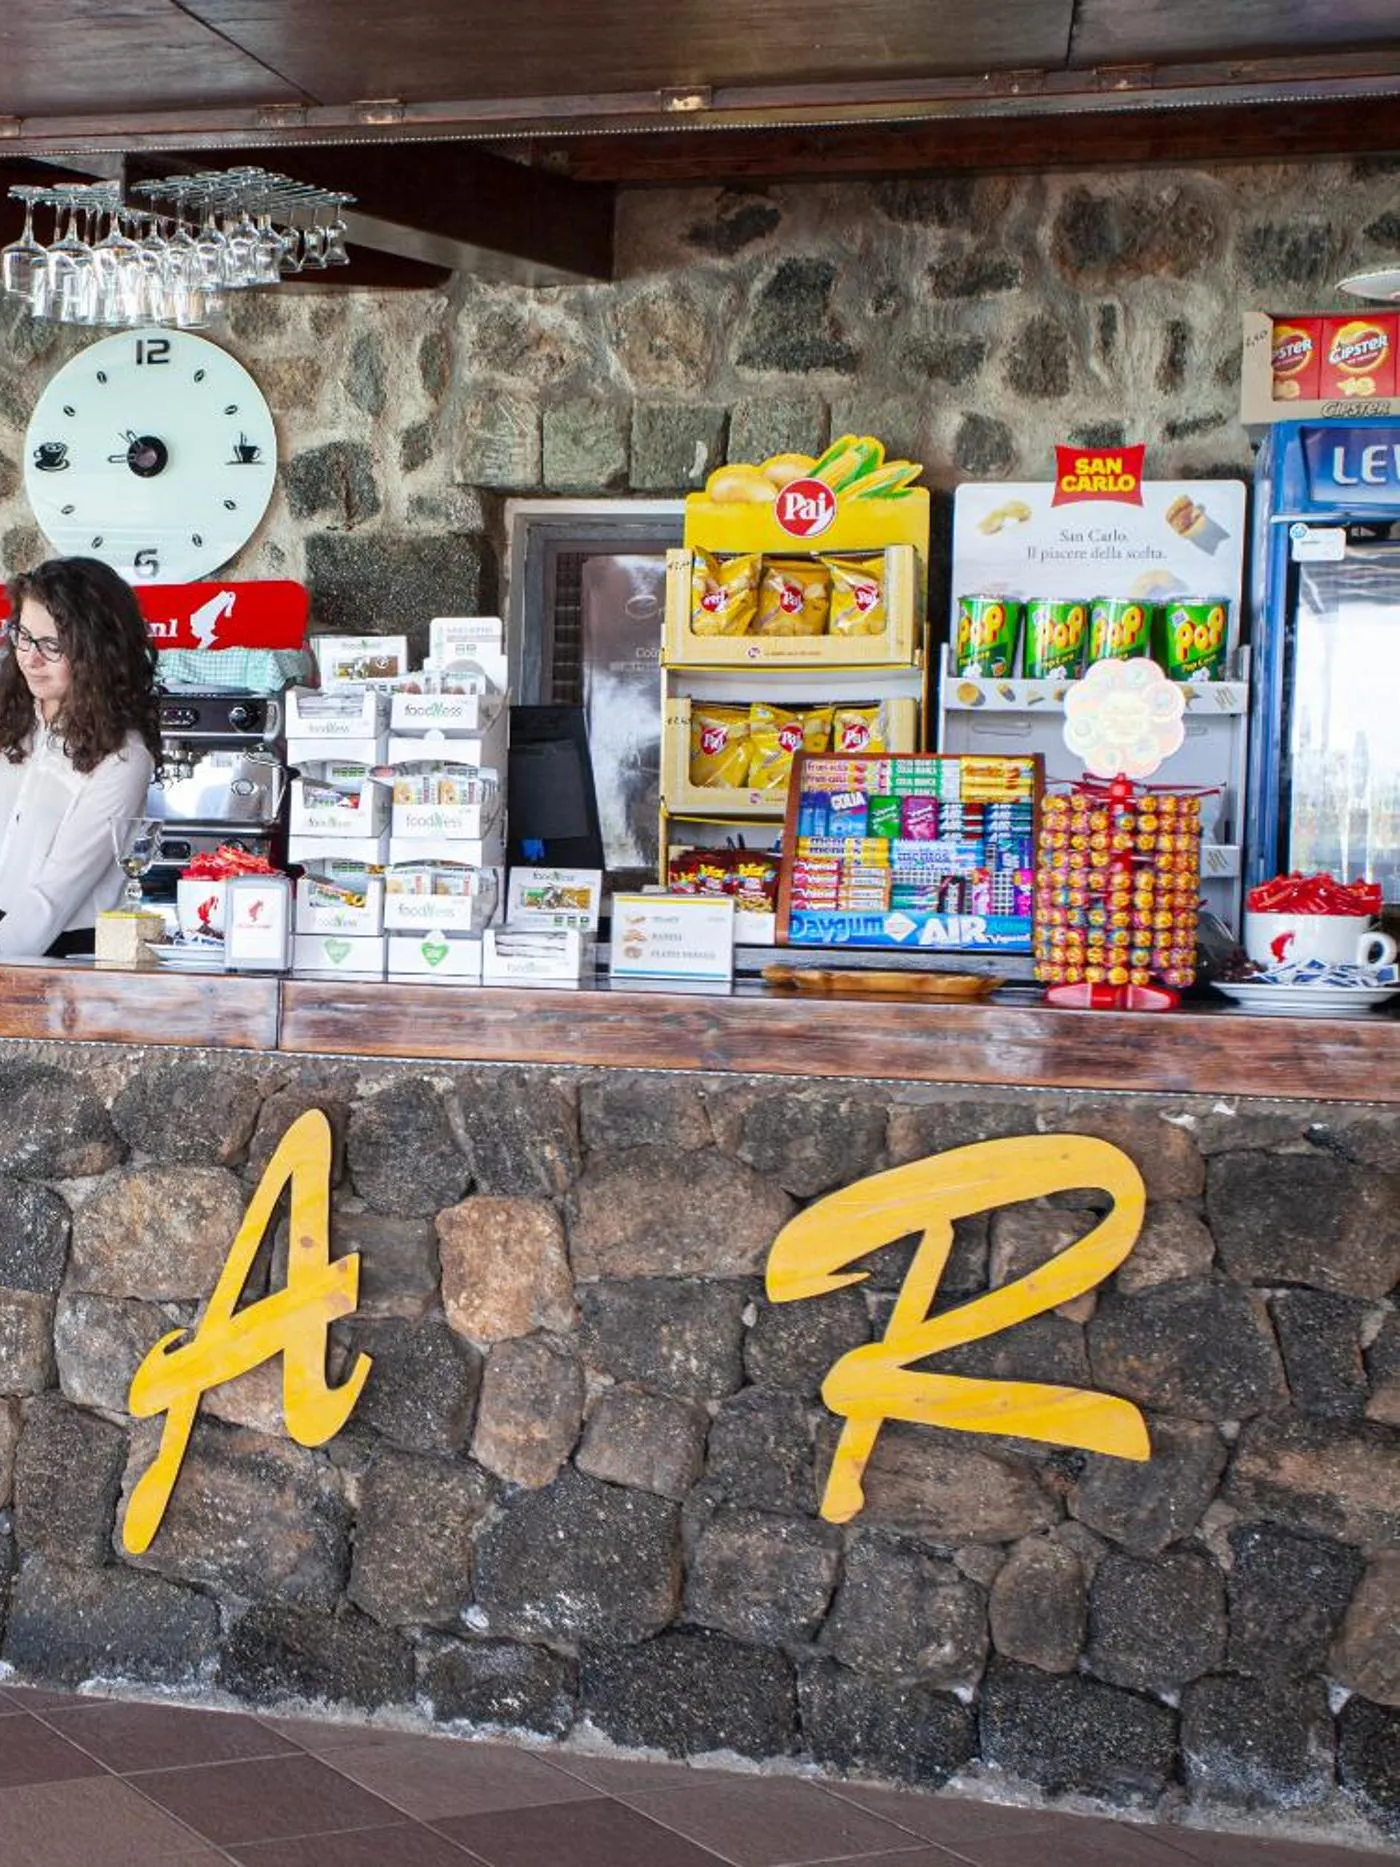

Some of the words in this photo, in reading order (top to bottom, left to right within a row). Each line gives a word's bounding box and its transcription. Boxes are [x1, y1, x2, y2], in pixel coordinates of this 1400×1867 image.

[135, 339, 170, 365] 12
[1074, 457, 1123, 475] SAN
[1332, 444, 1400, 485] LE
[1060, 474, 1137, 493] CARLO
[1059, 528, 1084, 542] San
[134, 548, 159, 578] 6
[1040, 546, 1088, 562] piacere
[1090, 545, 1123, 560] della
[791, 915, 884, 942] Daygum
[919, 915, 988, 945] AIR
